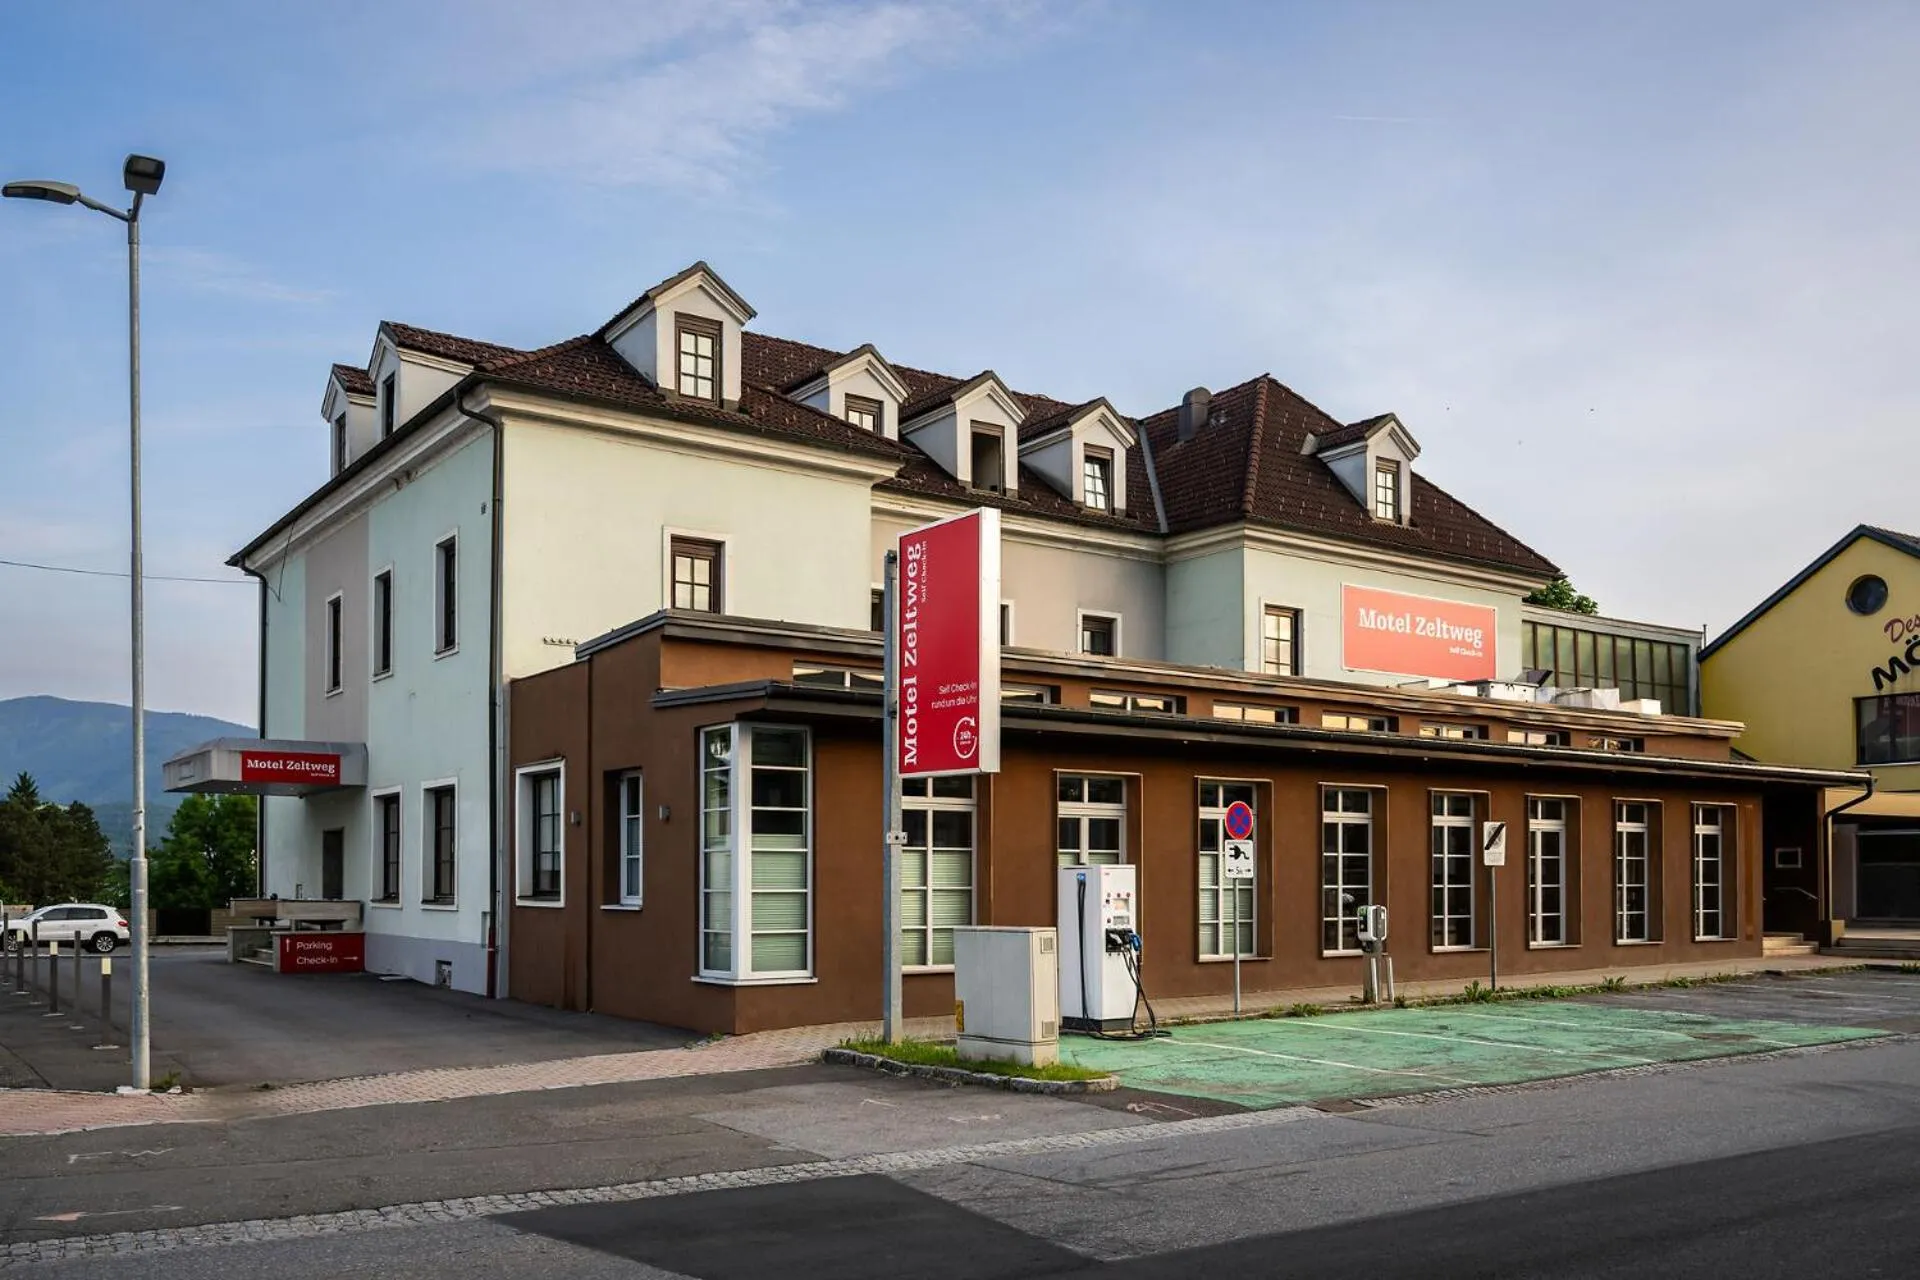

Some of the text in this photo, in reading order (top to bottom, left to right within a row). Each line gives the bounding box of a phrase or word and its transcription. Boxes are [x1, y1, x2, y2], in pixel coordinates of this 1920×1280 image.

[1358, 607, 1483, 648] Motel Zeltweg
[904, 543, 921, 765] Motel Zeltweg
[247, 758, 335, 774] Motel Zeltweg
[296, 941, 333, 950] Parking
